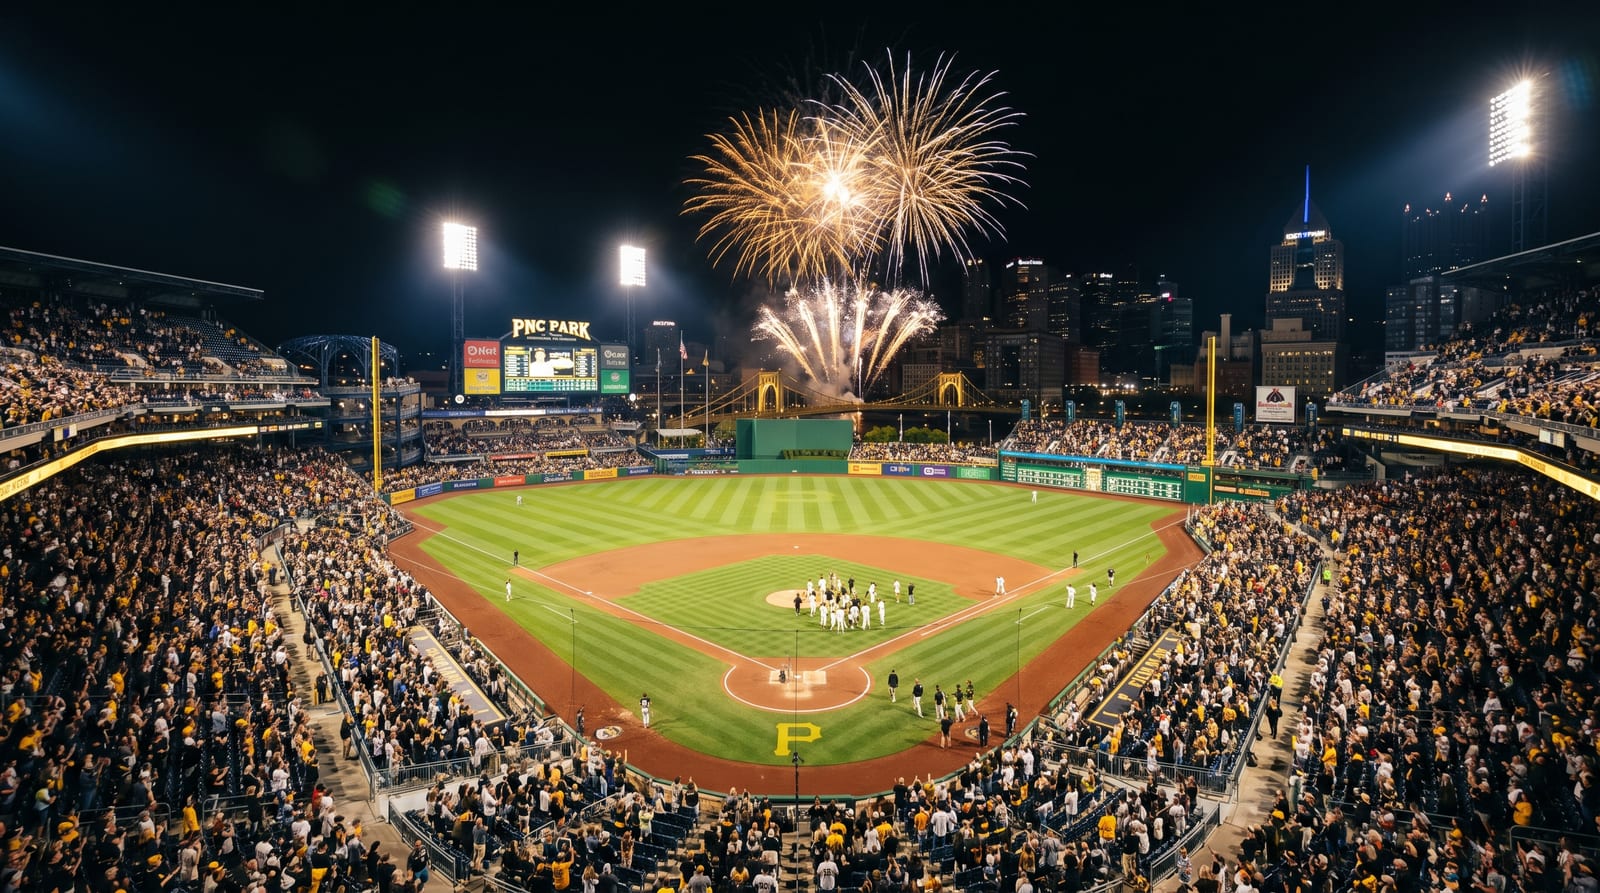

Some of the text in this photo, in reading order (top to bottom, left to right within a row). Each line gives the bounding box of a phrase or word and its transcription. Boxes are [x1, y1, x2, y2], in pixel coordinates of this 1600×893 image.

[512, 318, 592, 340] PNC PARK
[774, 722, 822, 756] P
